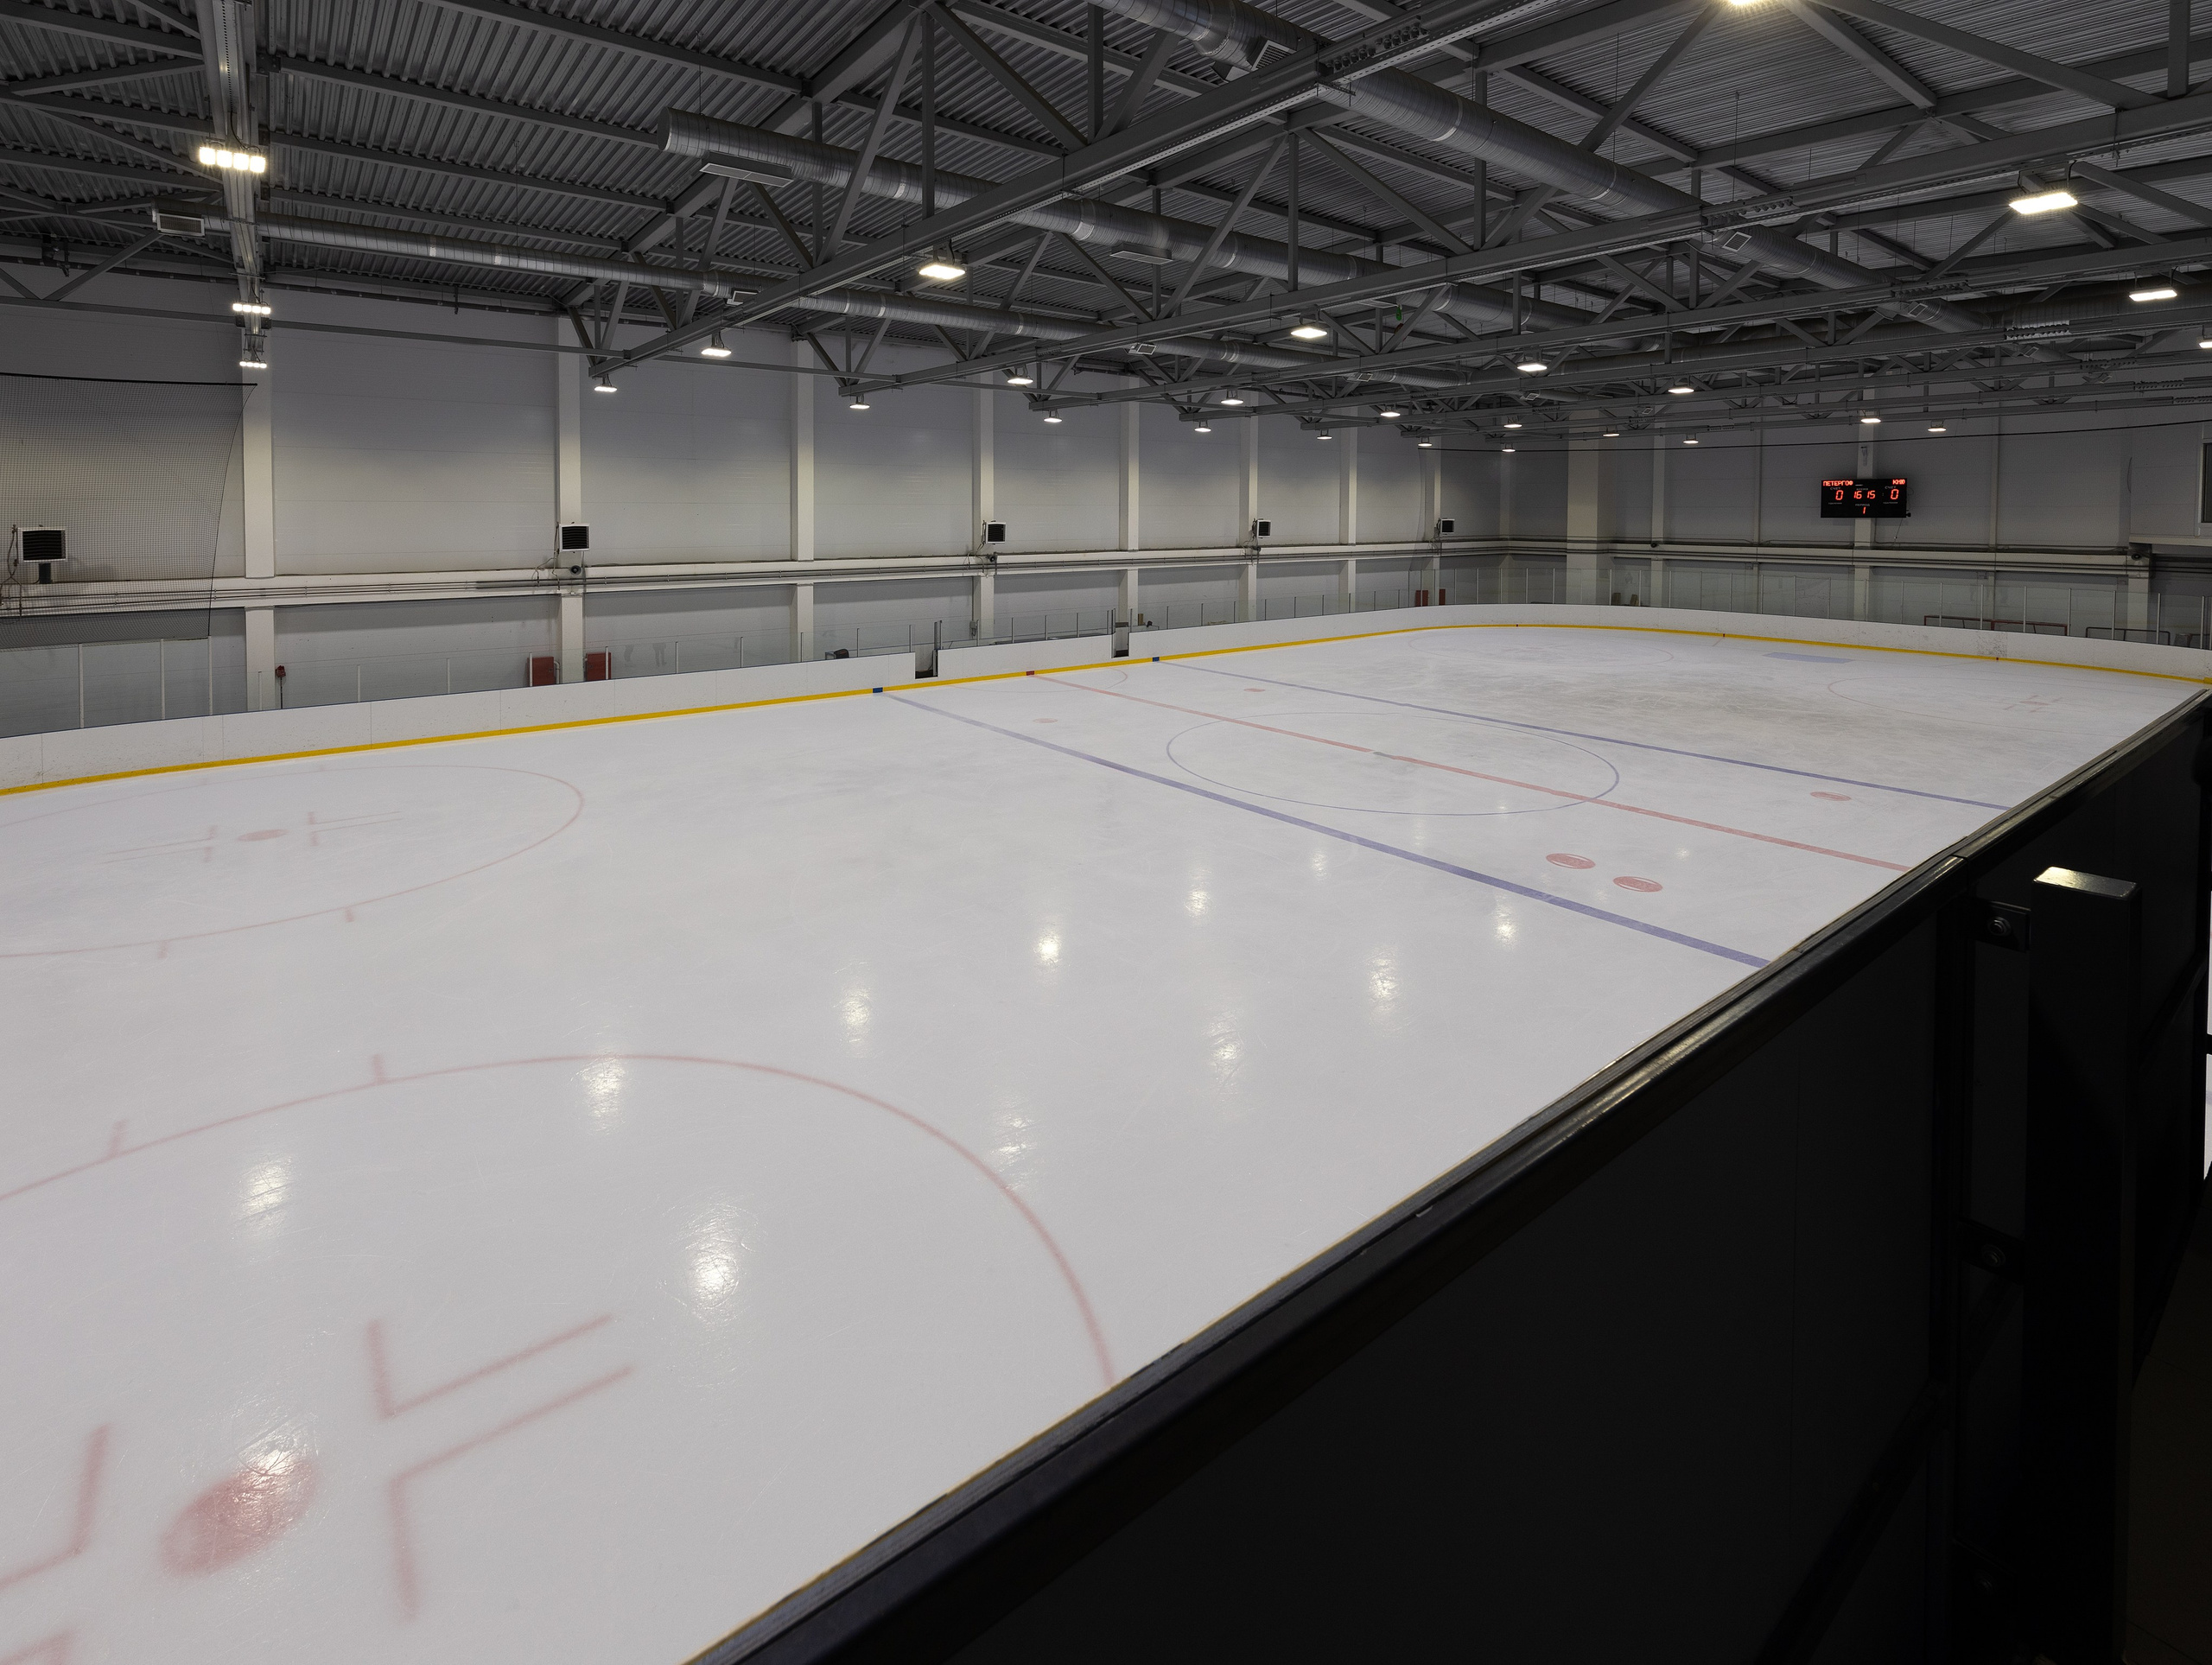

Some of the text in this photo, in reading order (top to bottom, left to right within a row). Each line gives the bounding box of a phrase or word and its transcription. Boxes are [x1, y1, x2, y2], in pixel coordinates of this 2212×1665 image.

[1835, 489, 1843, 500] 0
[1854, 490, 1875, 499] 16 15
[1891, 489, 1899, 500] 0
